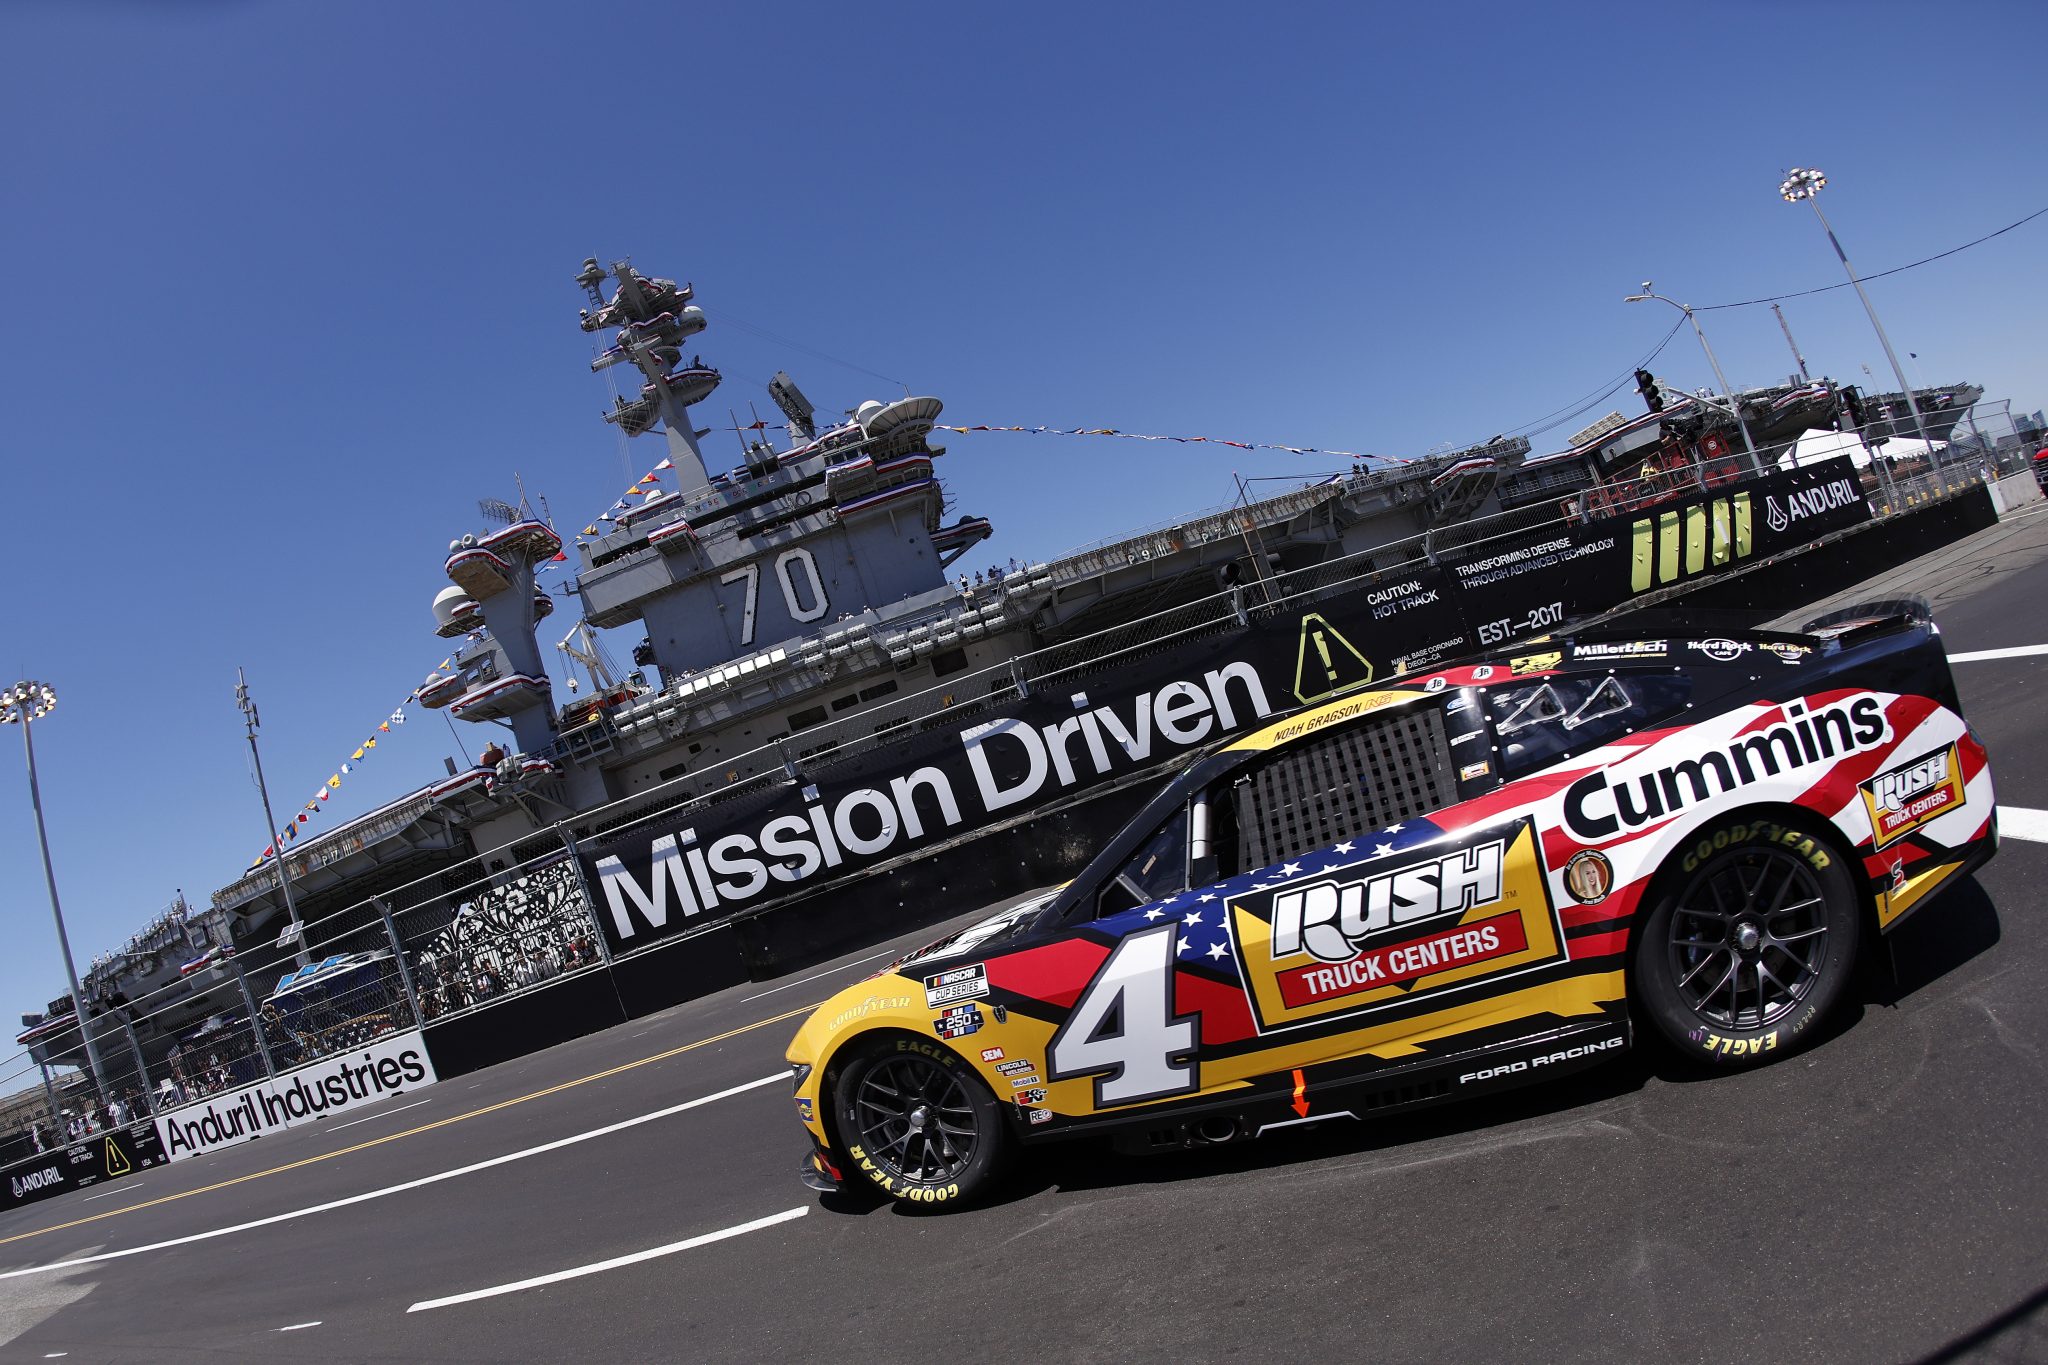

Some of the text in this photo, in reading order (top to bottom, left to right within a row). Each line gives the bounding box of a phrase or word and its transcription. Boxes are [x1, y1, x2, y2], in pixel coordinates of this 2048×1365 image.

[1788, 479, 1860, 522] ANDURIL
[1455, 537, 1572, 577] TRANSFORMING DEFENSE
[1460, 538, 1615, 590] THROUGH ADVANCED TECHNOLOGY
[720, 547, 831, 646] 70
[1367, 580, 1423, 605] CAUTION:
[1372, 589, 1440, 619] HOT TRACK
[1391, 637, 1464, 666] NAVAL BASE CORONADO
[1687, 641, 1753, 652] Hard Rock
[1759, 643, 1813, 654] Hard Rock
[960, 661, 1271, 812] Driven
[1273, 724, 1303, 743] NOAH
[1306, 703, 1363, 732] GRAGSON
[1563, 698, 1886, 839] Cummins
[1885, 790, 1948, 829] TRUCK CENTERS
[595, 766, 962, 940] Mission
[1682, 821, 1831, 872] GOODYEAR
[943, 968, 976, 985] NASCAR
[1302, 925, 1500, 995] TRUCK CENTERS
[935, 982, 979, 1000] CUP SERIES
[829, 996, 911, 1032] GOODYEAR
[946, 1013, 972, 1030] 250
[1050, 925, 1198, 1106] 4
[896, 1040, 956, 1067] EAGLE
[982, 1048, 1004, 1062] SEM
[1459, 1036, 1623, 1084] FORD RACING
[1703, 1031, 1778, 1055] EAGLE
[997, 1060, 1027, 1072] LINCOLN
[1013, 1078, 1030, 1087] Mobil
[167, 1050, 425, 1155] Anduril Industries
[22, 1166, 64, 1192] ANDURIL
[850, 1145, 959, 1203] GOODYEAR
